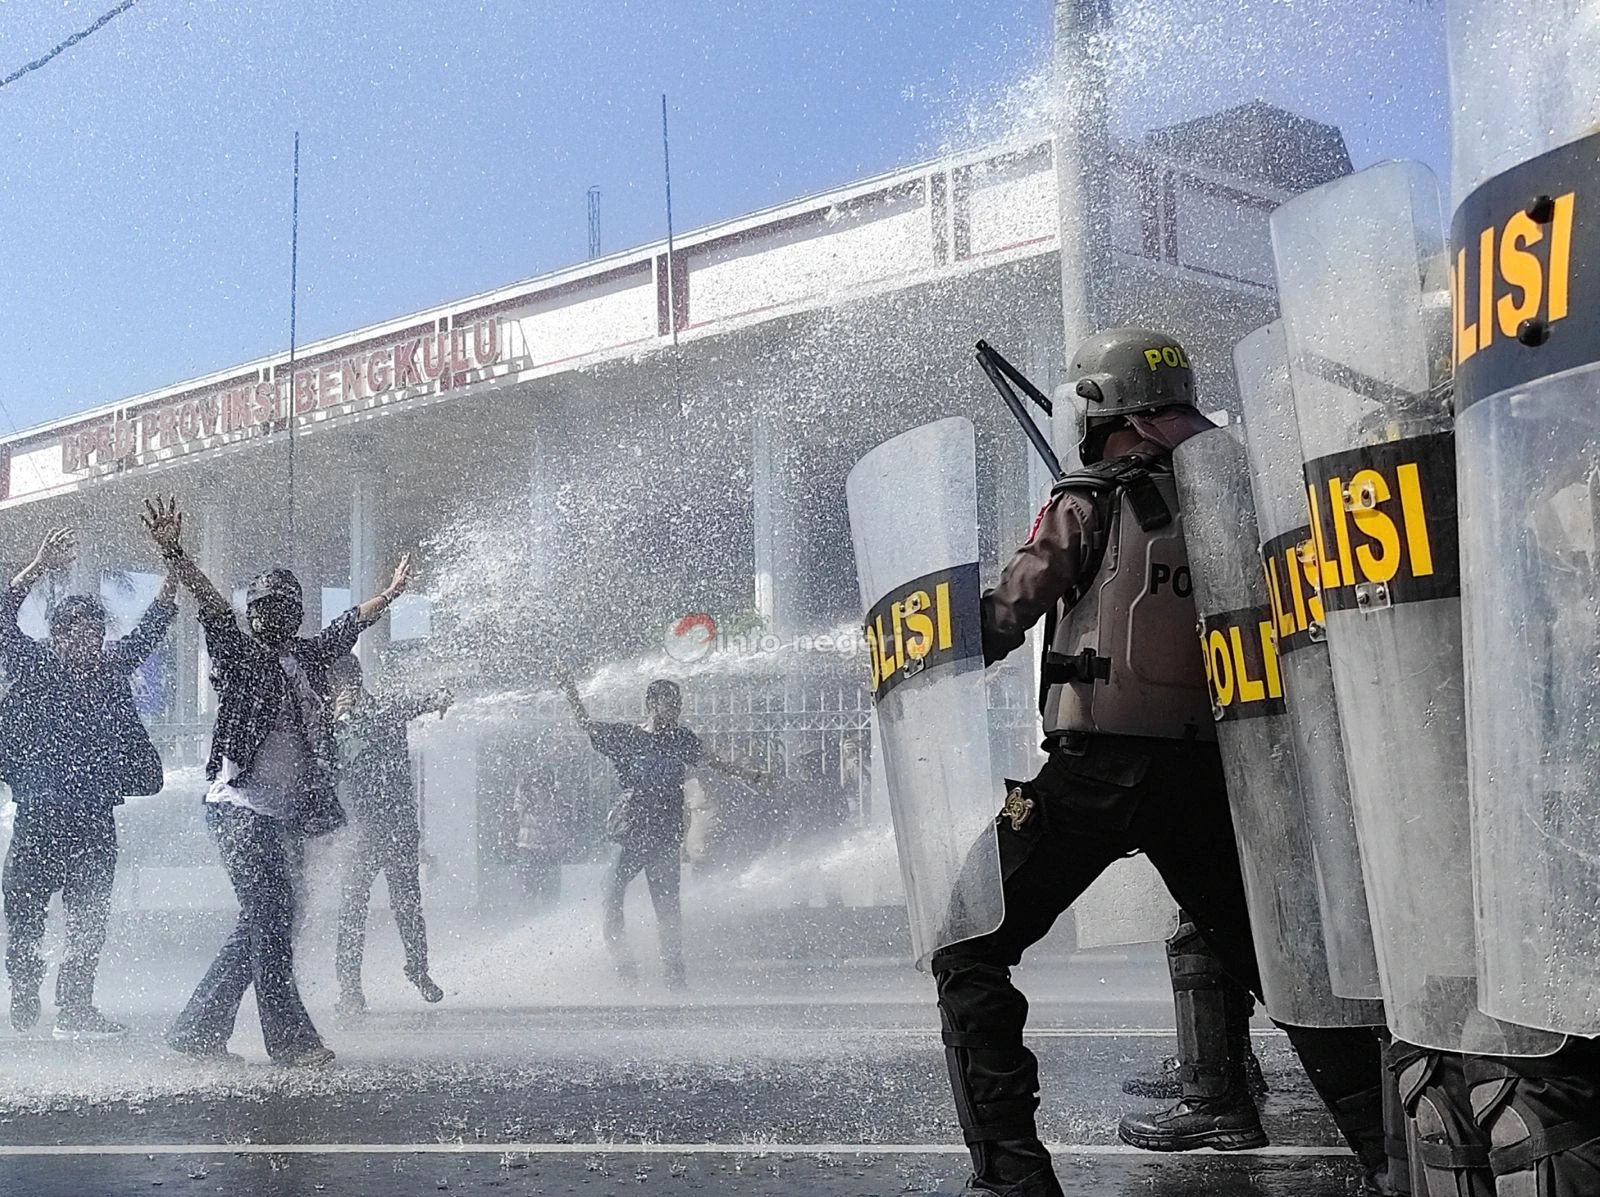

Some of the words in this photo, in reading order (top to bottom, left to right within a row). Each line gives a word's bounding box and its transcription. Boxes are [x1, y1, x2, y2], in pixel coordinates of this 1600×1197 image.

[1452, 192, 1574, 380] LISI
[142, 380, 285, 451] PROVINSI
[293, 319, 500, 415] BENGKULU
[1151, 563, 1193, 598] PO
[1308, 463, 1433, 589] LISI
